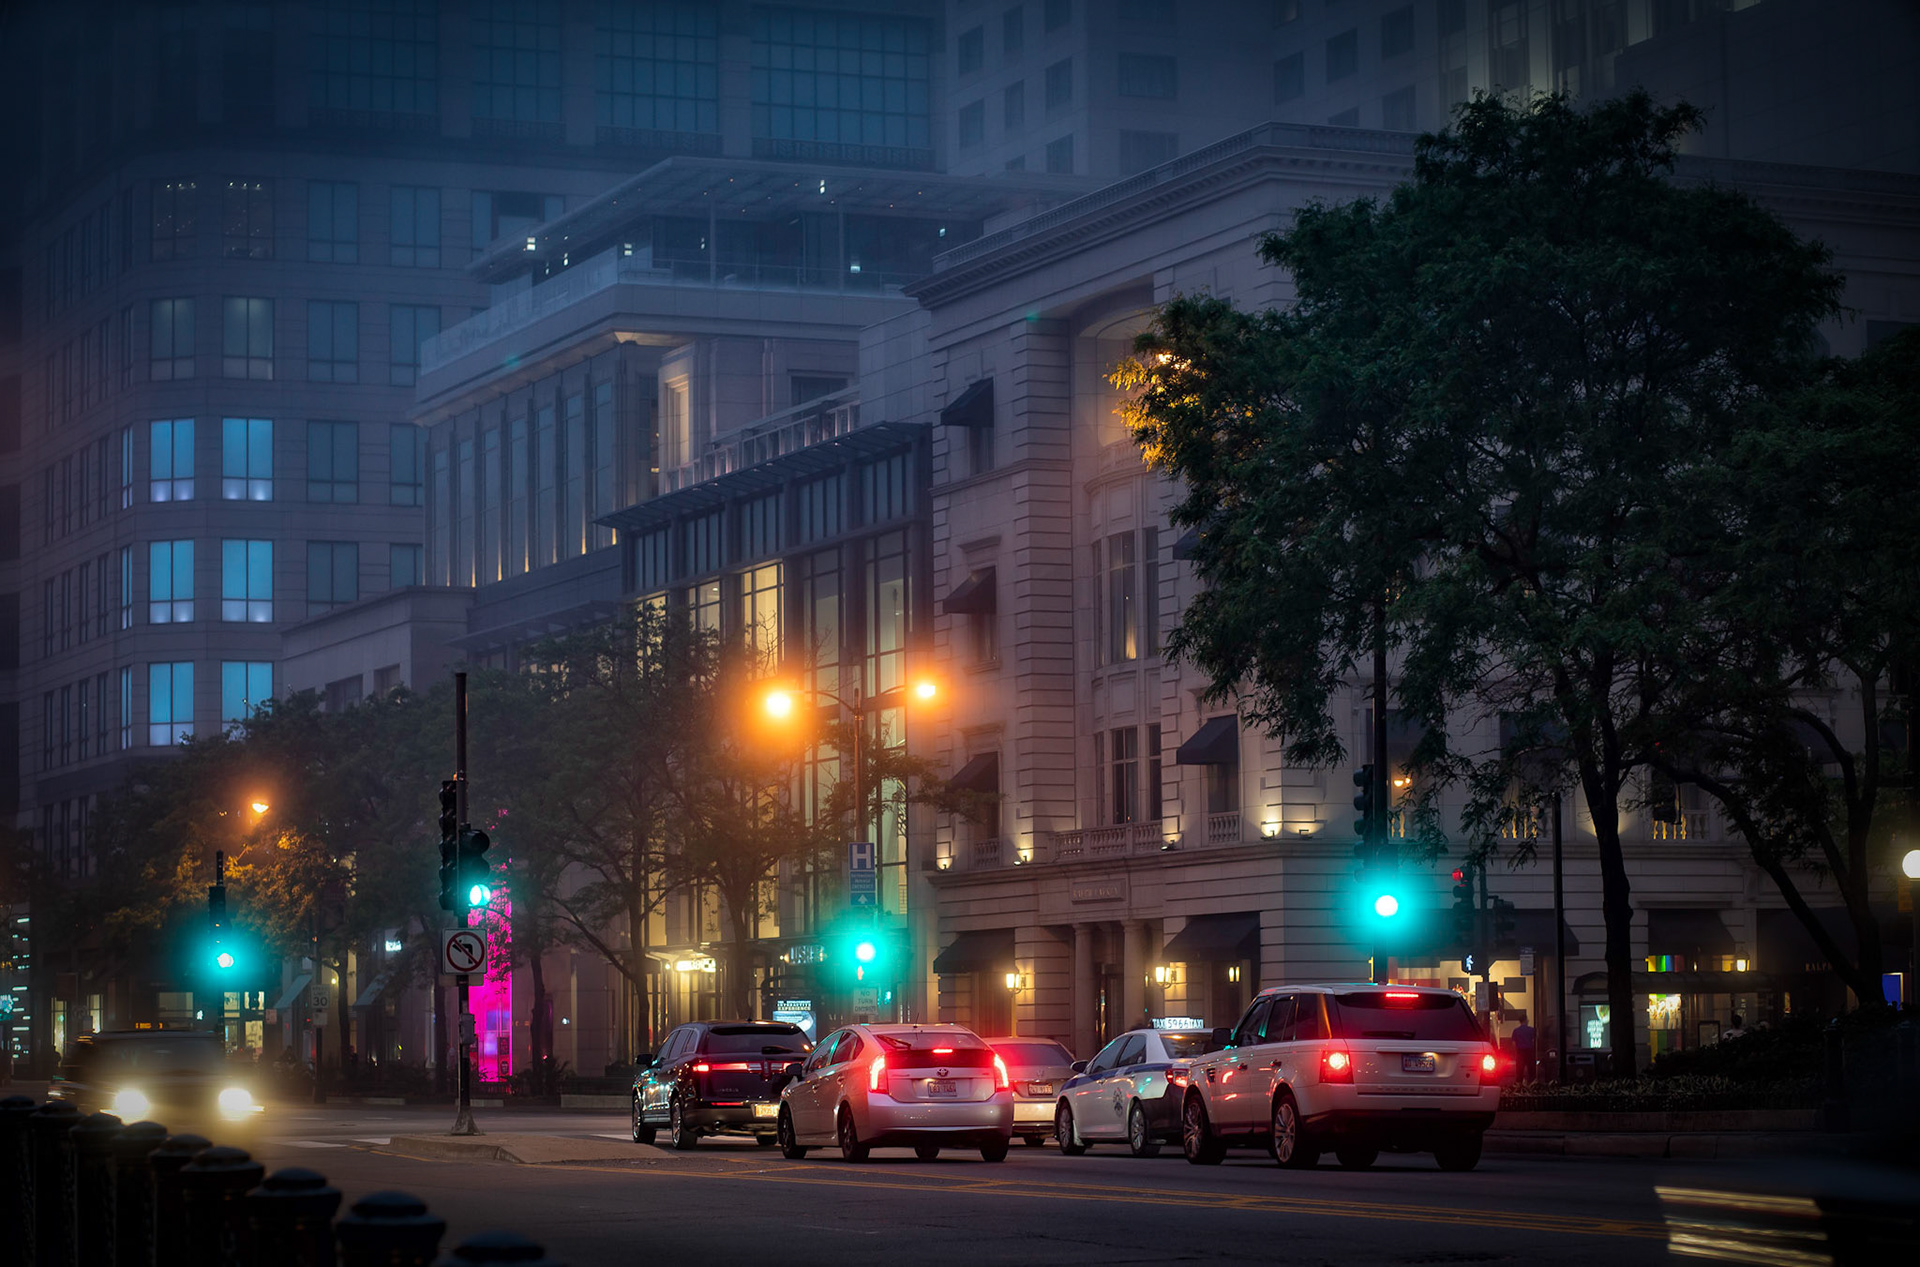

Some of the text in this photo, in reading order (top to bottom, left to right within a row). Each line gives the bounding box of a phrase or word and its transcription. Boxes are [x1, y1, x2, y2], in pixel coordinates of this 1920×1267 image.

[852, 844, 872, 869] H
[313, 997, 327, 1006] 30
[1152, 1019, 1165, 1029] TAXI
[1190, 1019, 1203, 1029] TAXI
